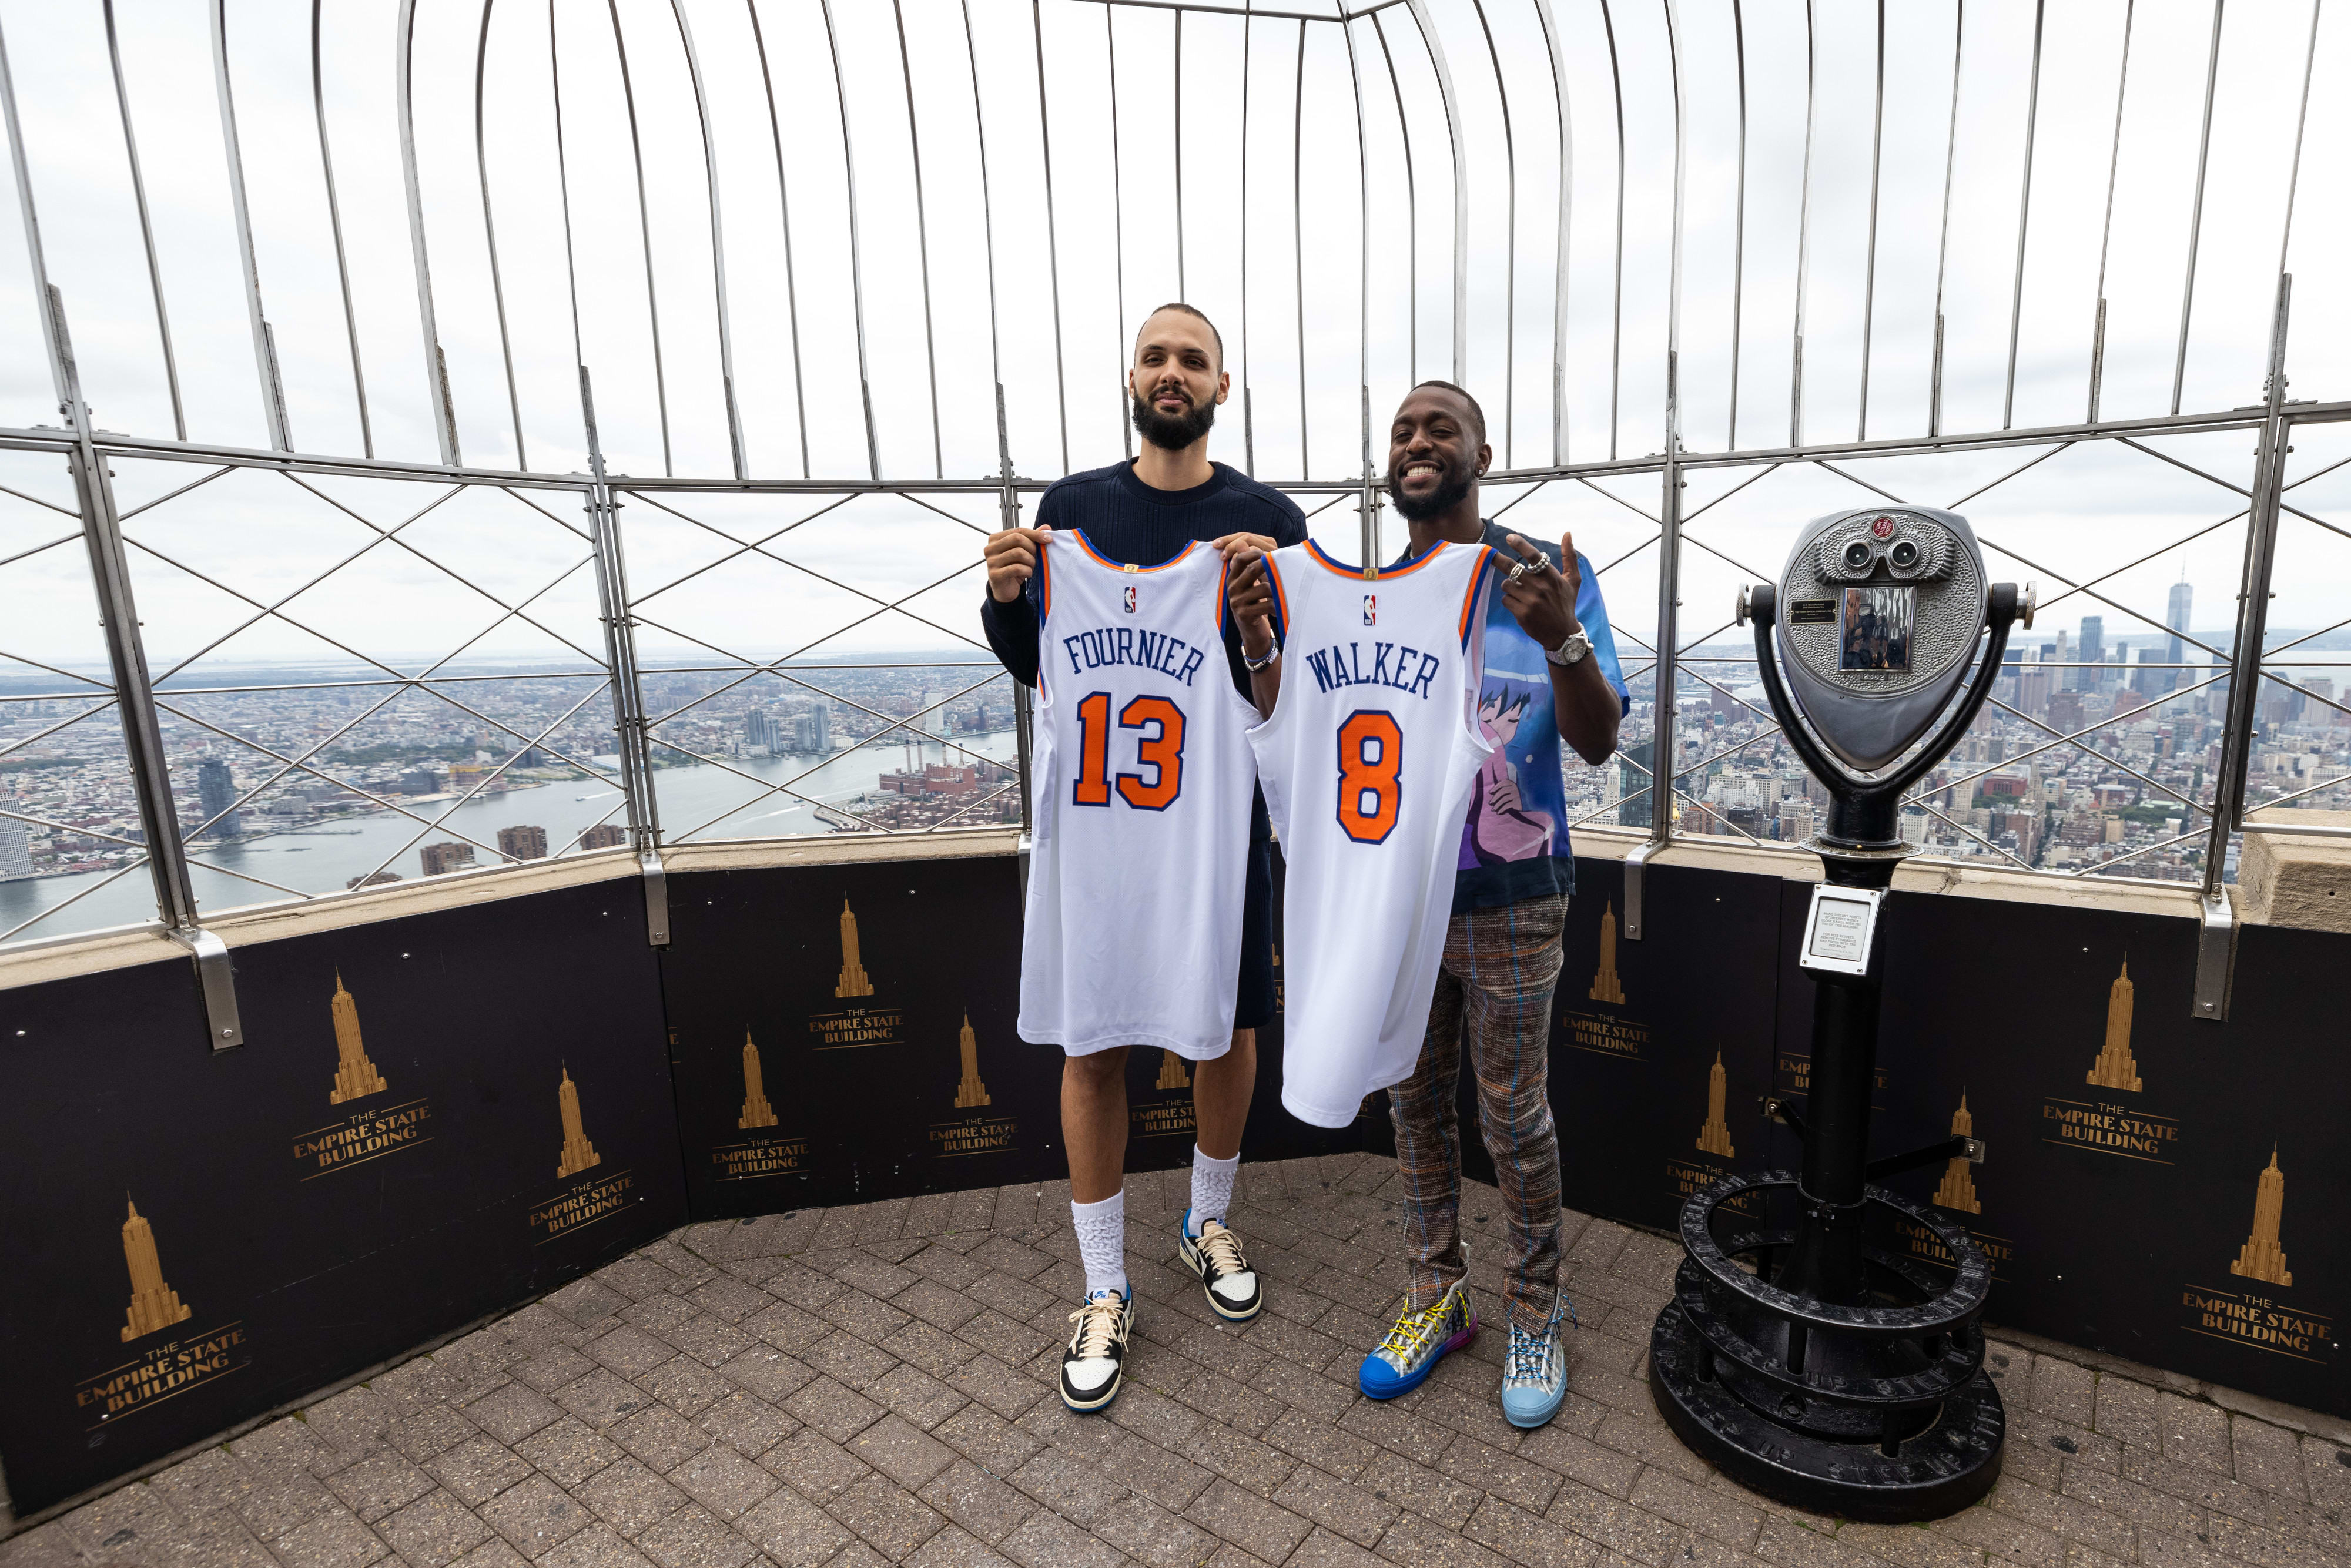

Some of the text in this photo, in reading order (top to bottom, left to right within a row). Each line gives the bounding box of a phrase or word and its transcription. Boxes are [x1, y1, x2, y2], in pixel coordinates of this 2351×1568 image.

[1881, 519, 1889, 531] CLEAR
[1884, 523, 1892, 535] VISION
[1063, 628, 1204, 687] FOURNIER
[1305, 642, 1439, 700] WALKER
[1072, 691, 1187, 812] 13
[1336, 709, 1404, 845] 8
[846, 1009, 866, 1017] THE
[1598, 1013, 1616, 1023] THE
[809, 1015, 903, 1033] EMPIRE STATE
[1562, 1016, 1651, 1043] EMPIRE STATE
[824, 1027, 893, 1044] BUILDING
[1575, 1031, 1639, 1054] BUILDING
[1779, 1058, 1811, 1075] EMP
[349, 1110, 377, 1125] THE
[1131, 1108, 1178, 1122] EMPIRE
[2098, 1102, 2125, 1115] THE
[293, 1105, 431, 1160] EMPIRE STATE
[929, 1123, 1019, 1141] EMPIRE STATE
[1144, 1117, 1197, 1132] BUILDIN
[2043, 1105, 2178, 1141] EMPIRE STATE
[317, 1125, 417, 1167] BUILDING
[750, 1138, 770, 1148] THE
[943, 1135, 1009, 1151] BUILDING
[2061, 1123, 2159, 1154] BUILDING
[711, 1143, 809, 1165] EMPIRE STATE
[728, 1157, 799, 1175] BUILDING
[1704, 1164, 1724, 1176] THE
[571, 1181, 593, 1195] THE
[530, 1175, 635, 1227] EMPIRE STATE
[548, 1194, 624, 1233] BUILDING
[2243, 1294, 2273, 1309] THE
[2182, 1292, 2332, 1341] EMPIRE STATE
[2202, 1312, 2309, 1352] BUILDING
[145, 1341, 178, 1361] THE
[75, 1328, 246, 1408] EMPIRE STATE
[107, 1352, 229, 1413] BUILDING
[1827, 1460, 1915, 1485] STEP
